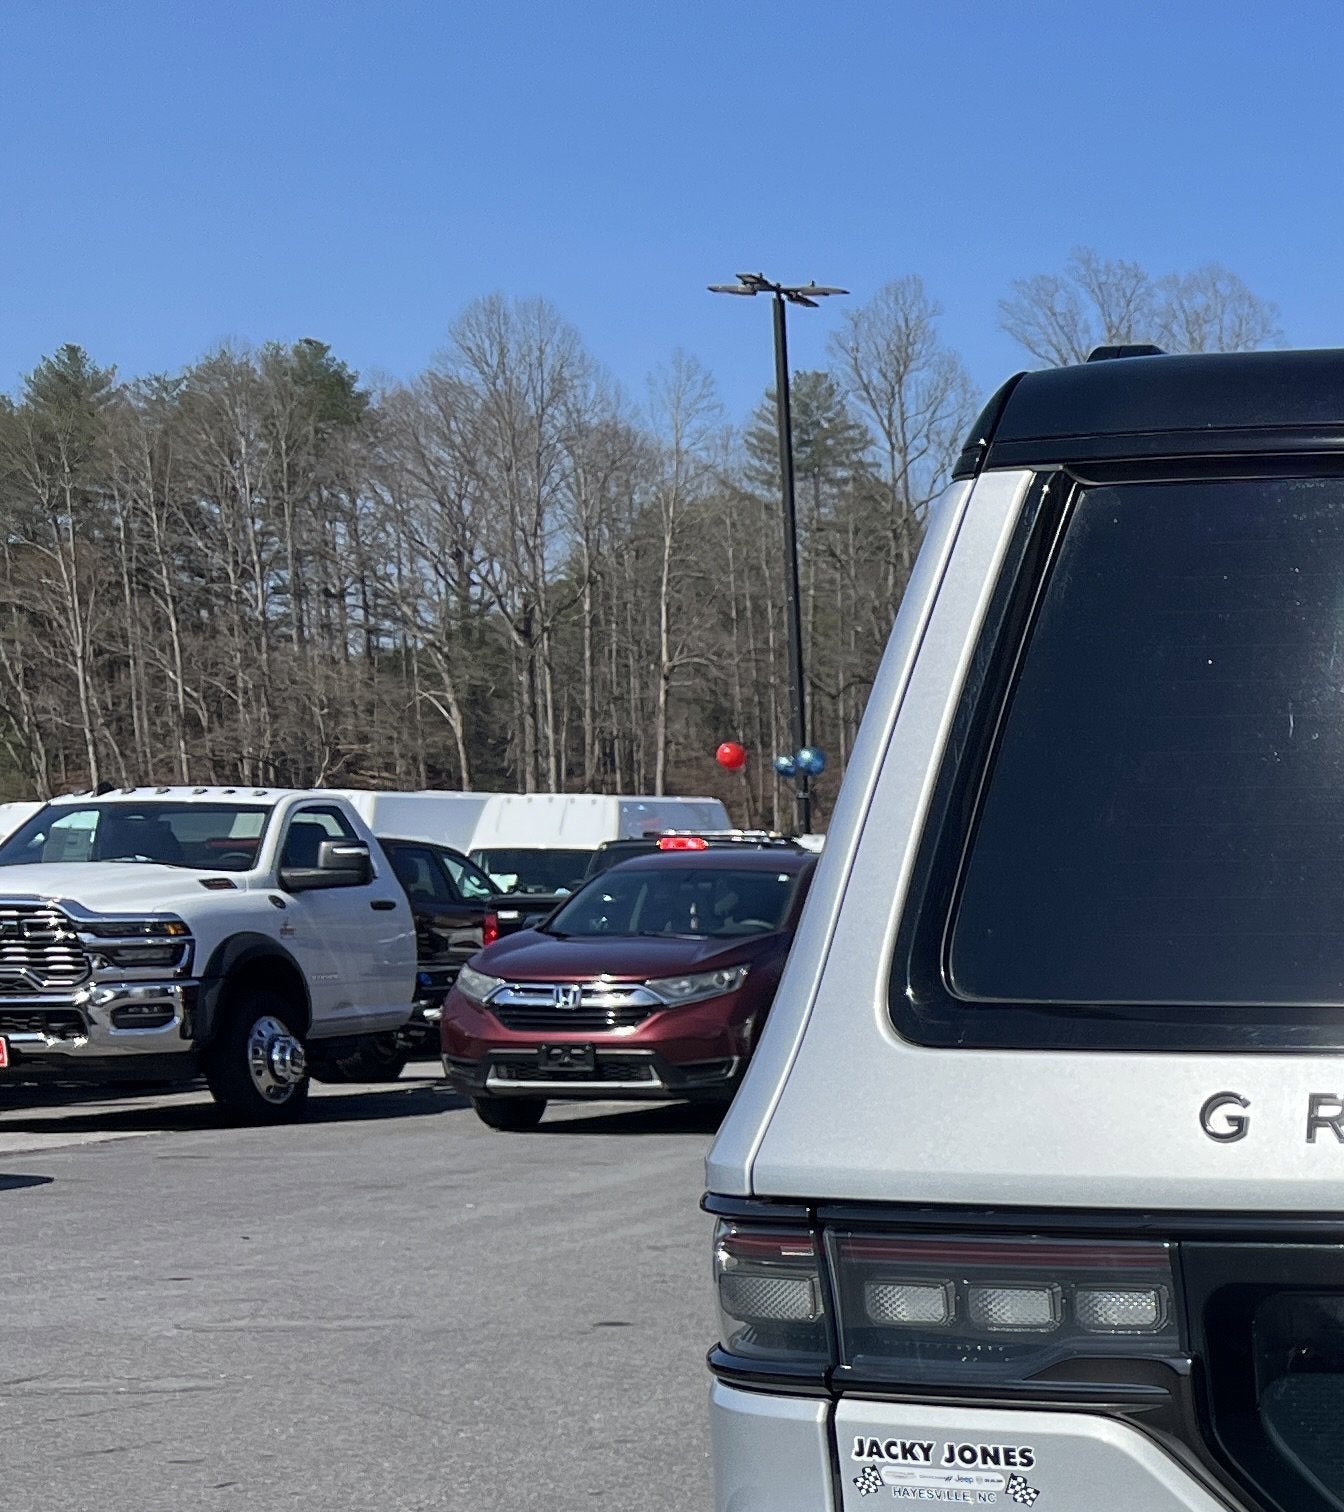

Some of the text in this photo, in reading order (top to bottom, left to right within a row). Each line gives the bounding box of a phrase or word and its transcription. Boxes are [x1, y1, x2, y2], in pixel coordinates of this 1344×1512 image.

[853, 1438, 1036, 1469] JACKY JONES
[978, 1492, 996, 1503] NC
